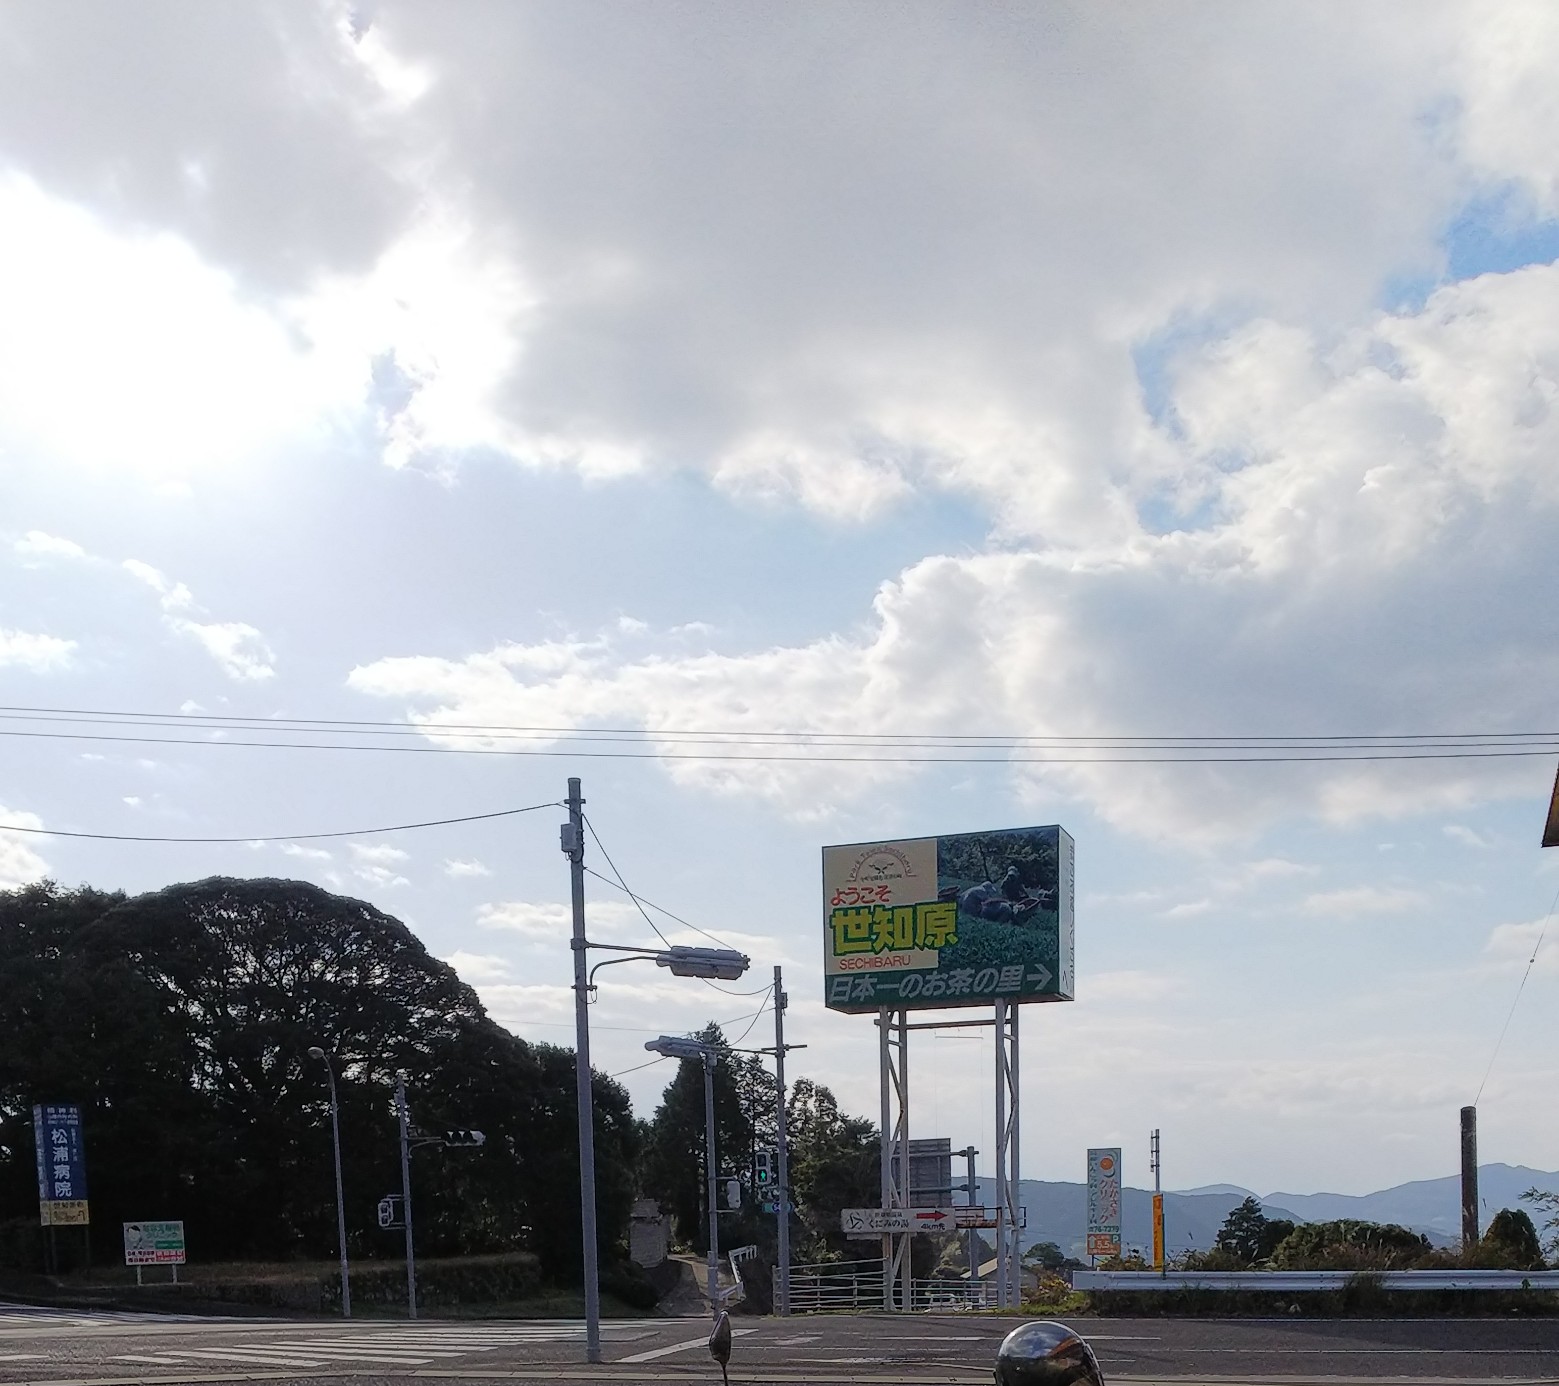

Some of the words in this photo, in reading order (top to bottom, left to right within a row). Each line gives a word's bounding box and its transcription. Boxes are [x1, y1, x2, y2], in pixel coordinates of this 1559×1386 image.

[831, 885, 892, 906] ようこそ
[830, 901, 959, 956] 世知原
[839, 955, 911, 970] SECHIBARU
[829, 964, 1025, 1003] 日本一のお茶の里
[51, 1128, 72, 1197] 松浦病院
